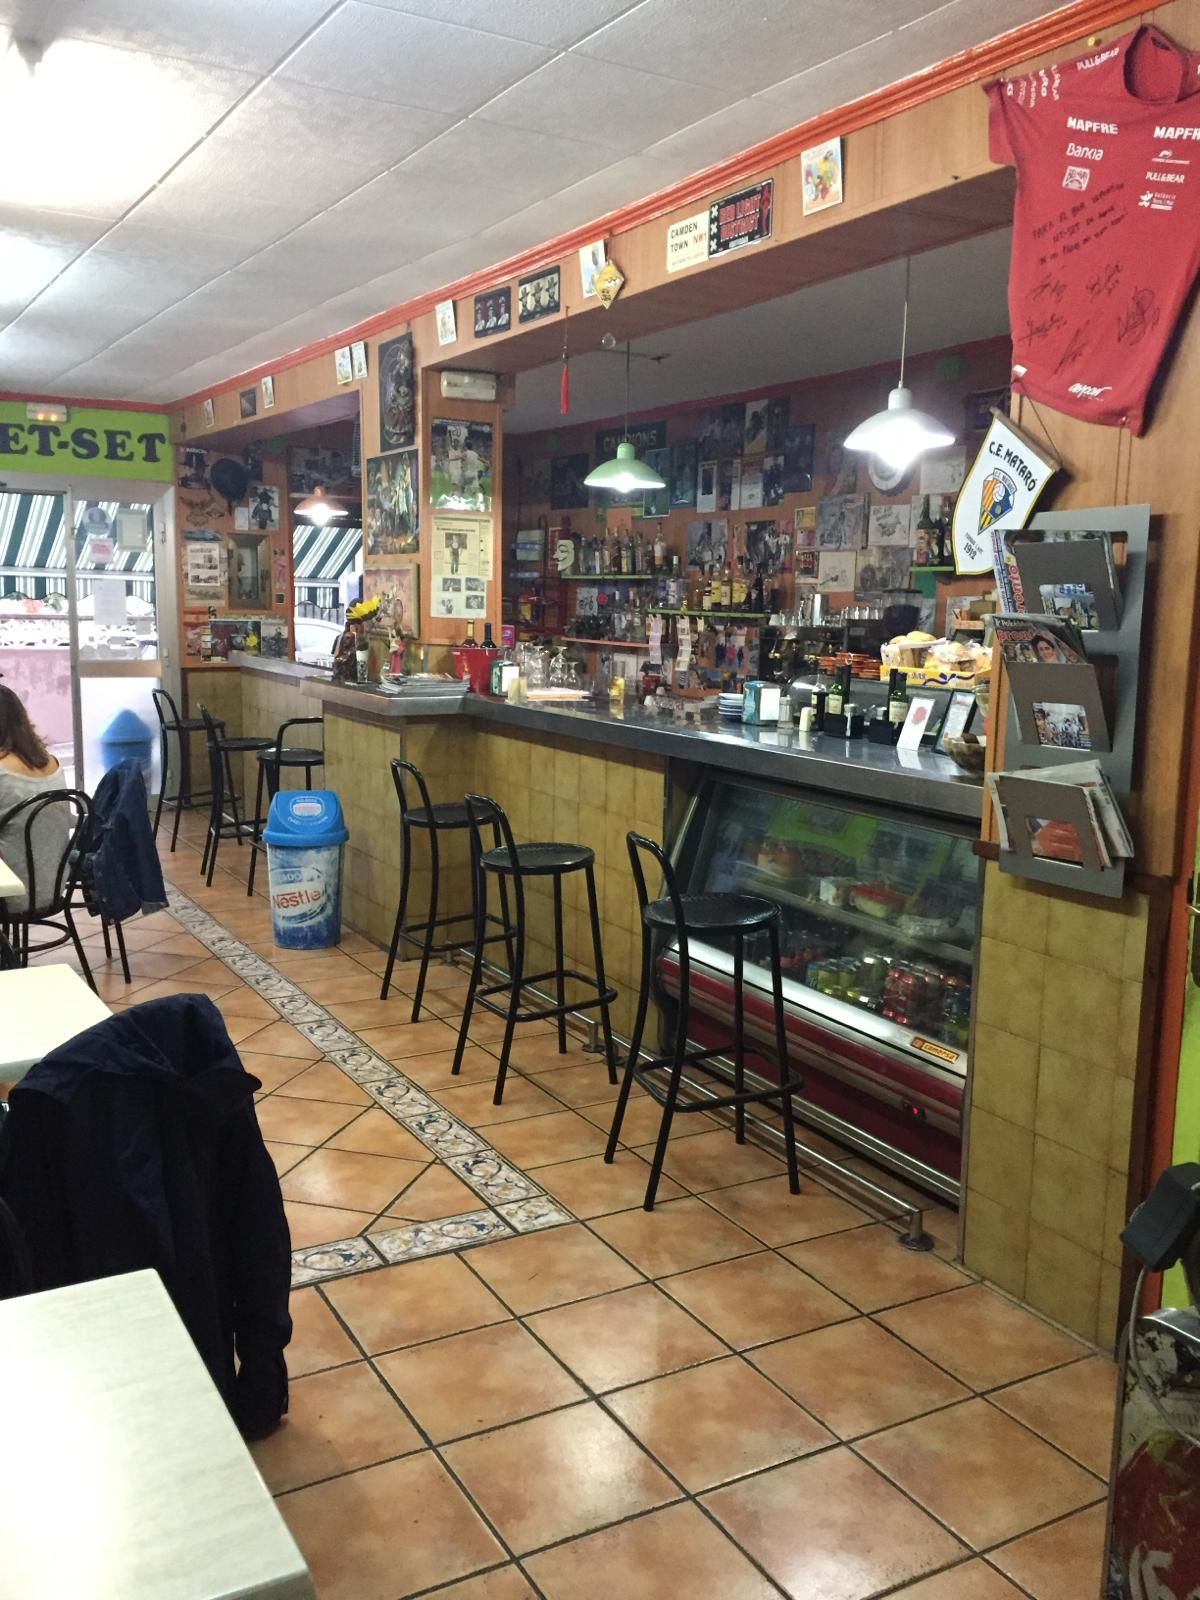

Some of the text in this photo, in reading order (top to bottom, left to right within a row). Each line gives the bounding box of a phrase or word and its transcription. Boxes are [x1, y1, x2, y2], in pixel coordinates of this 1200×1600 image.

[1066, 116, 1119, 135] MAPFRE
[1065, 142, 1104, 161] Bankia
[1145, 171, 1185, 184] PULL&BEAR
[670, 221, 698, 240] CAMDEN
[670, 240, 689, 253] TOWN
[0, 422, 167, 464] ET-SET
[1001, 447, 1038, 492] MATARÓ
[1008, 563, 1026, 615] ronto
